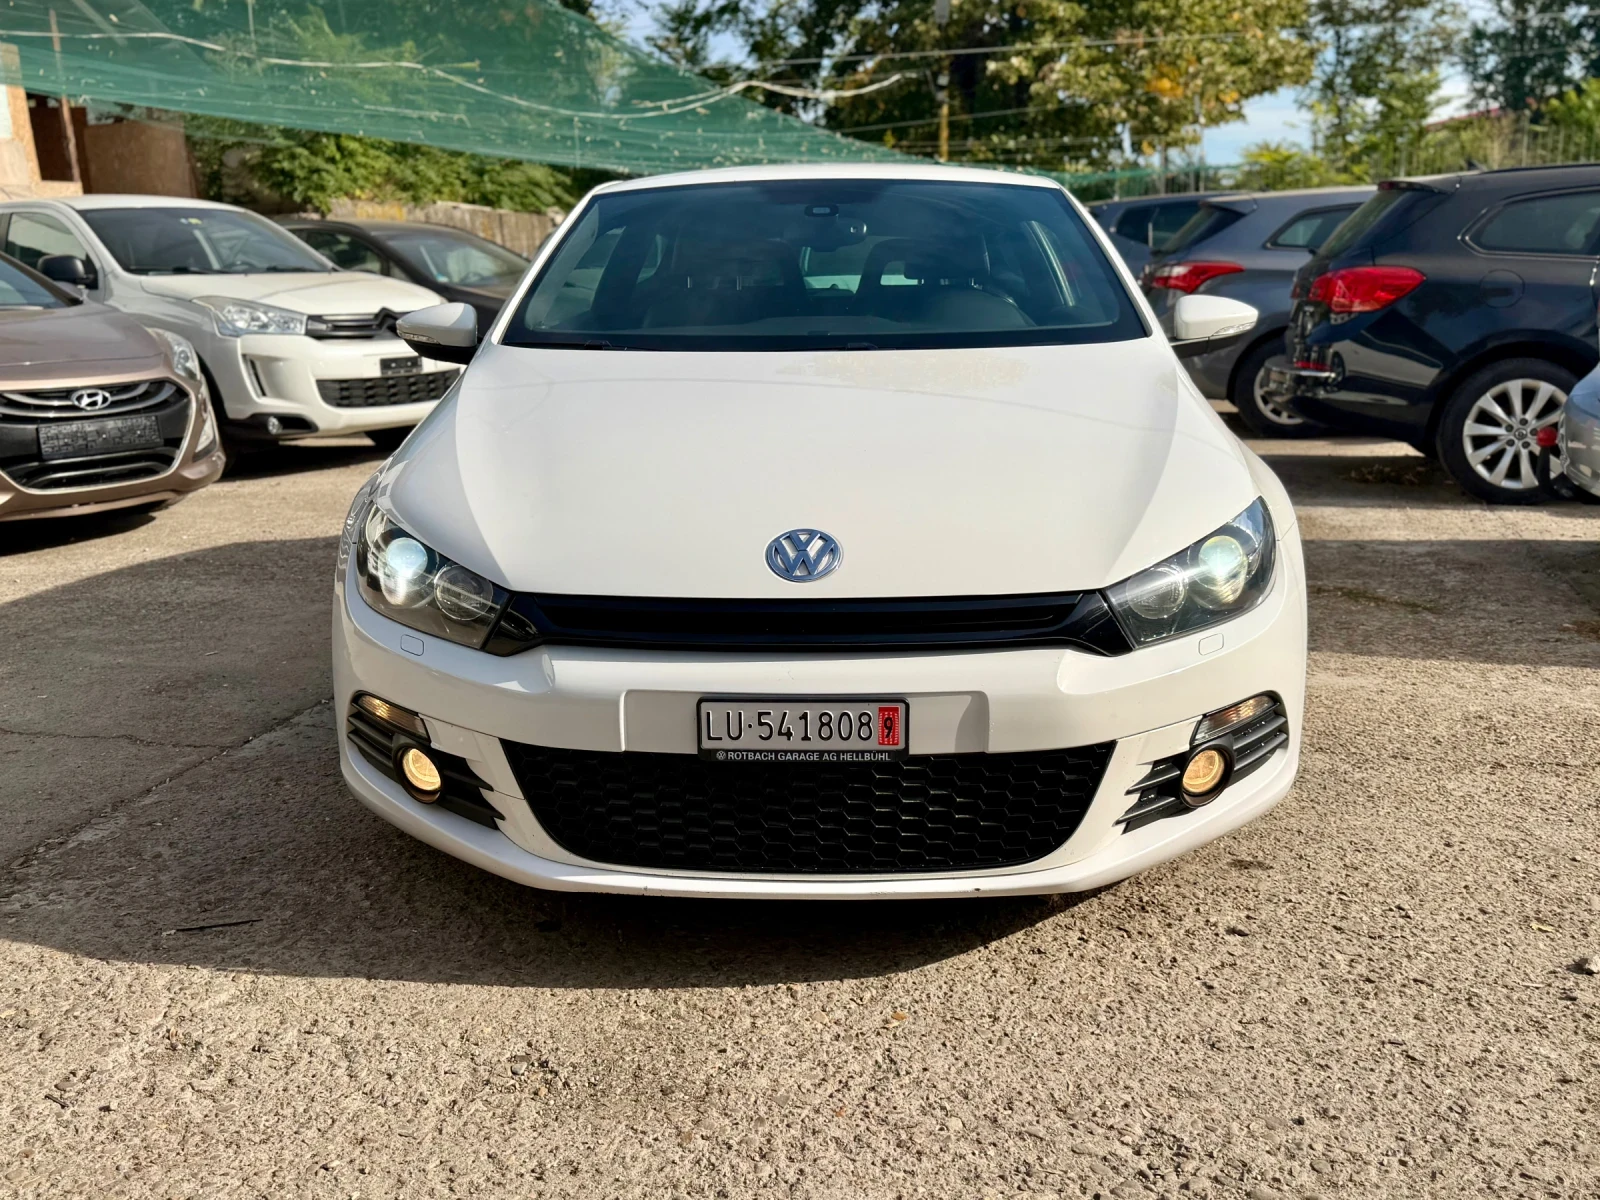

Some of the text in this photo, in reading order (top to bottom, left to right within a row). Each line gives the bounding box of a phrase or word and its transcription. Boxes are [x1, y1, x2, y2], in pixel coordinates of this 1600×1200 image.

[883, 716, 894, 739] 9
[727, 751, 775, 761] ROTBACH
[777, 752, 820, 761] GARAGE
[822, 752, 837, 761] AG
[840, 750, 892, 761] HELLBÜHL
